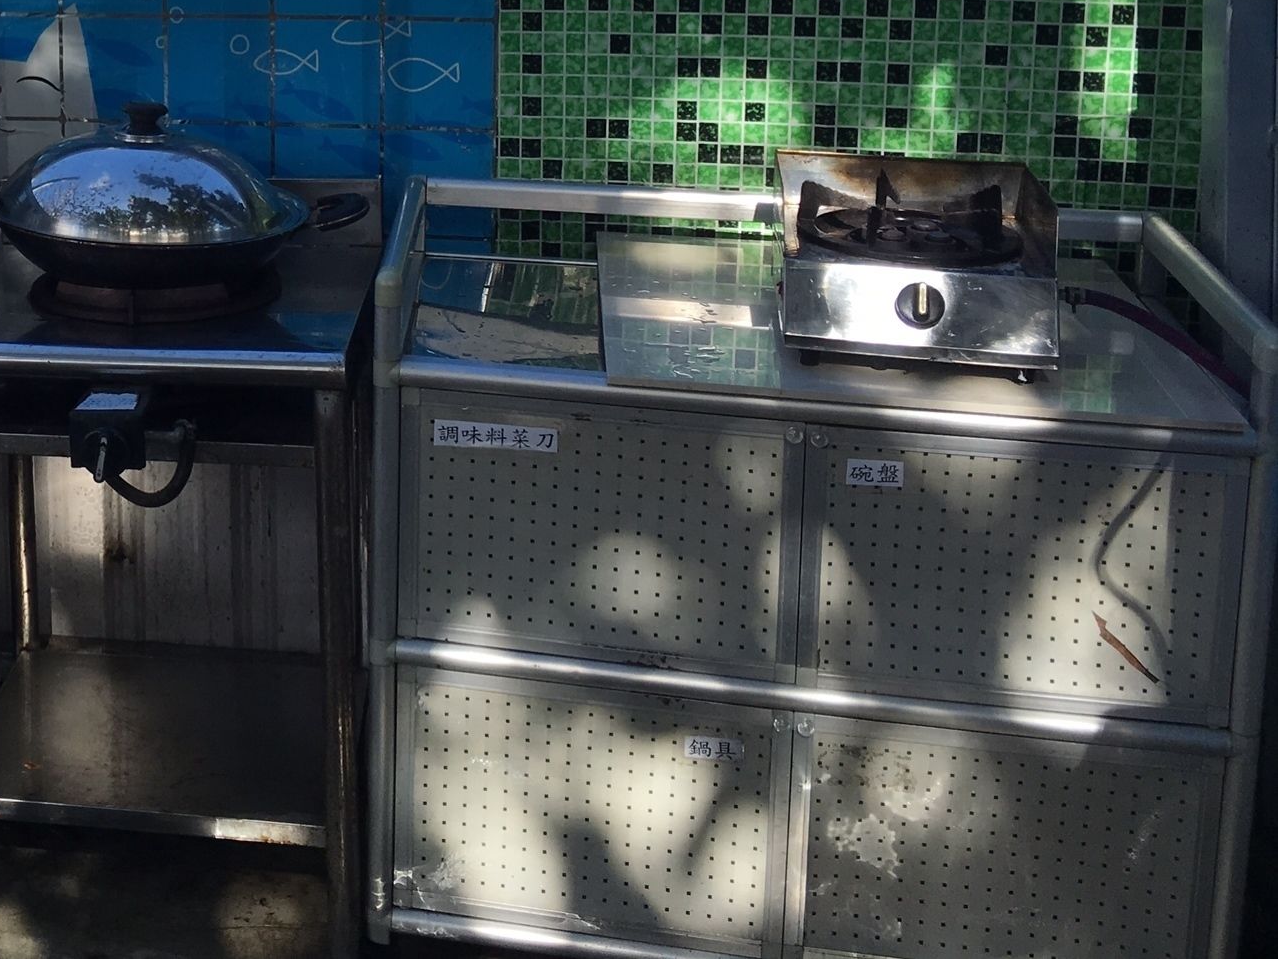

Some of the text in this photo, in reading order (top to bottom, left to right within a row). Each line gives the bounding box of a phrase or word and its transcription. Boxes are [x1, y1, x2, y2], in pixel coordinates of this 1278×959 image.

[437, 425, 555, 450] 調味料菜刀
[849, 462, 900, 484] 碗盤
[688, 738, 737, 760] 鍋具
